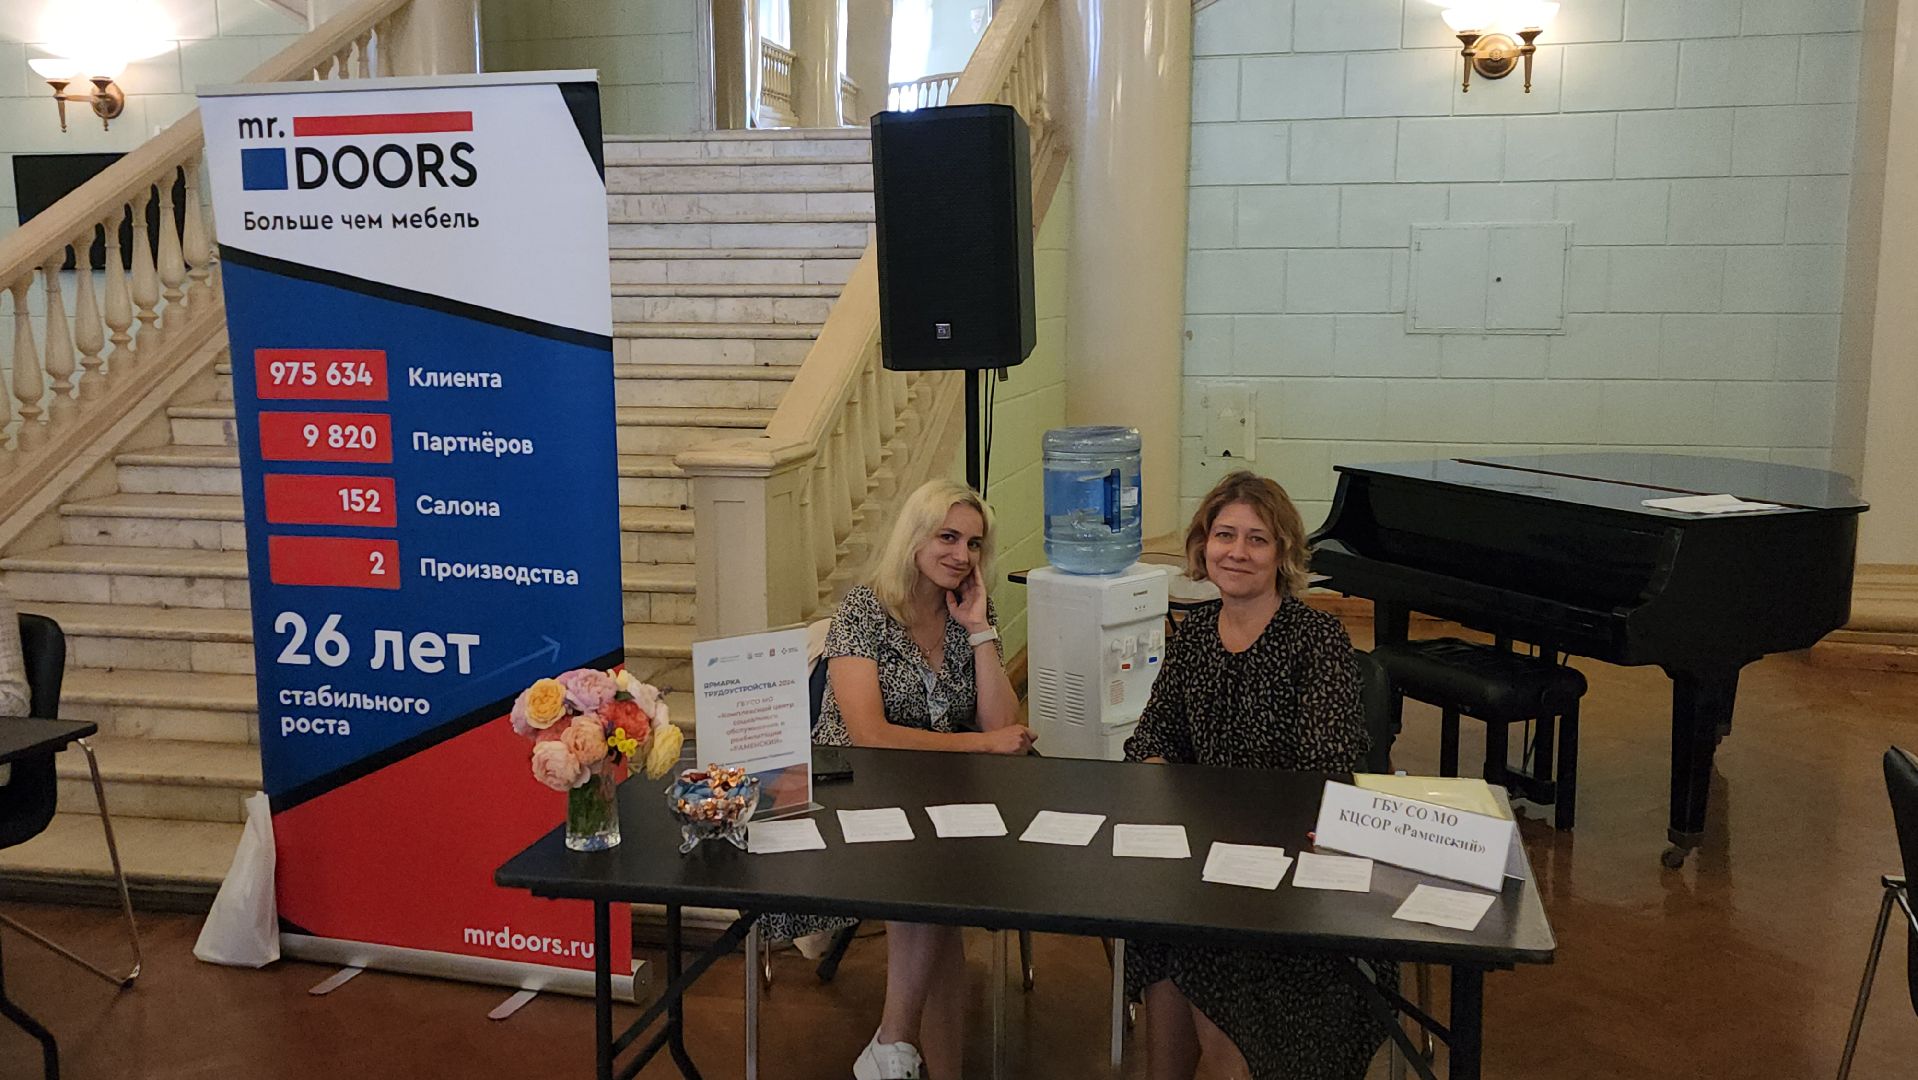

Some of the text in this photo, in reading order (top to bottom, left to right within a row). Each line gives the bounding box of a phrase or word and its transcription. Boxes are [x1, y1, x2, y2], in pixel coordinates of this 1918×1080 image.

[238, 117, 285, 139] mr.
[295, 141, 478, 190] DOORS
[243, 205, 479, 231] Больше чем мебель
[269, 361, 502, 388] 975 634 Клиента
[302, 423, 534, 458] 9 820 Партнёров
[338, 488, 501, 517] 152 Салона
[369, 551, 579, 586] 2 Производства
[274, 610, 480, 675] 26 лет
[704, 678, 740, 690] ЯРМАРКА
[704, 681, 777, 699] ТРУДОУСТРОЙСТВА
[279, 684, 430, 715] стабильного
[280, 715, 351, 737] роста
[1371, 797, 1458, 827] ГБУ СО МО
[1338, 808, 1486, 855] КЦСОР «Раменский»
[464, 926, 595, 959] mrdoors.ru
